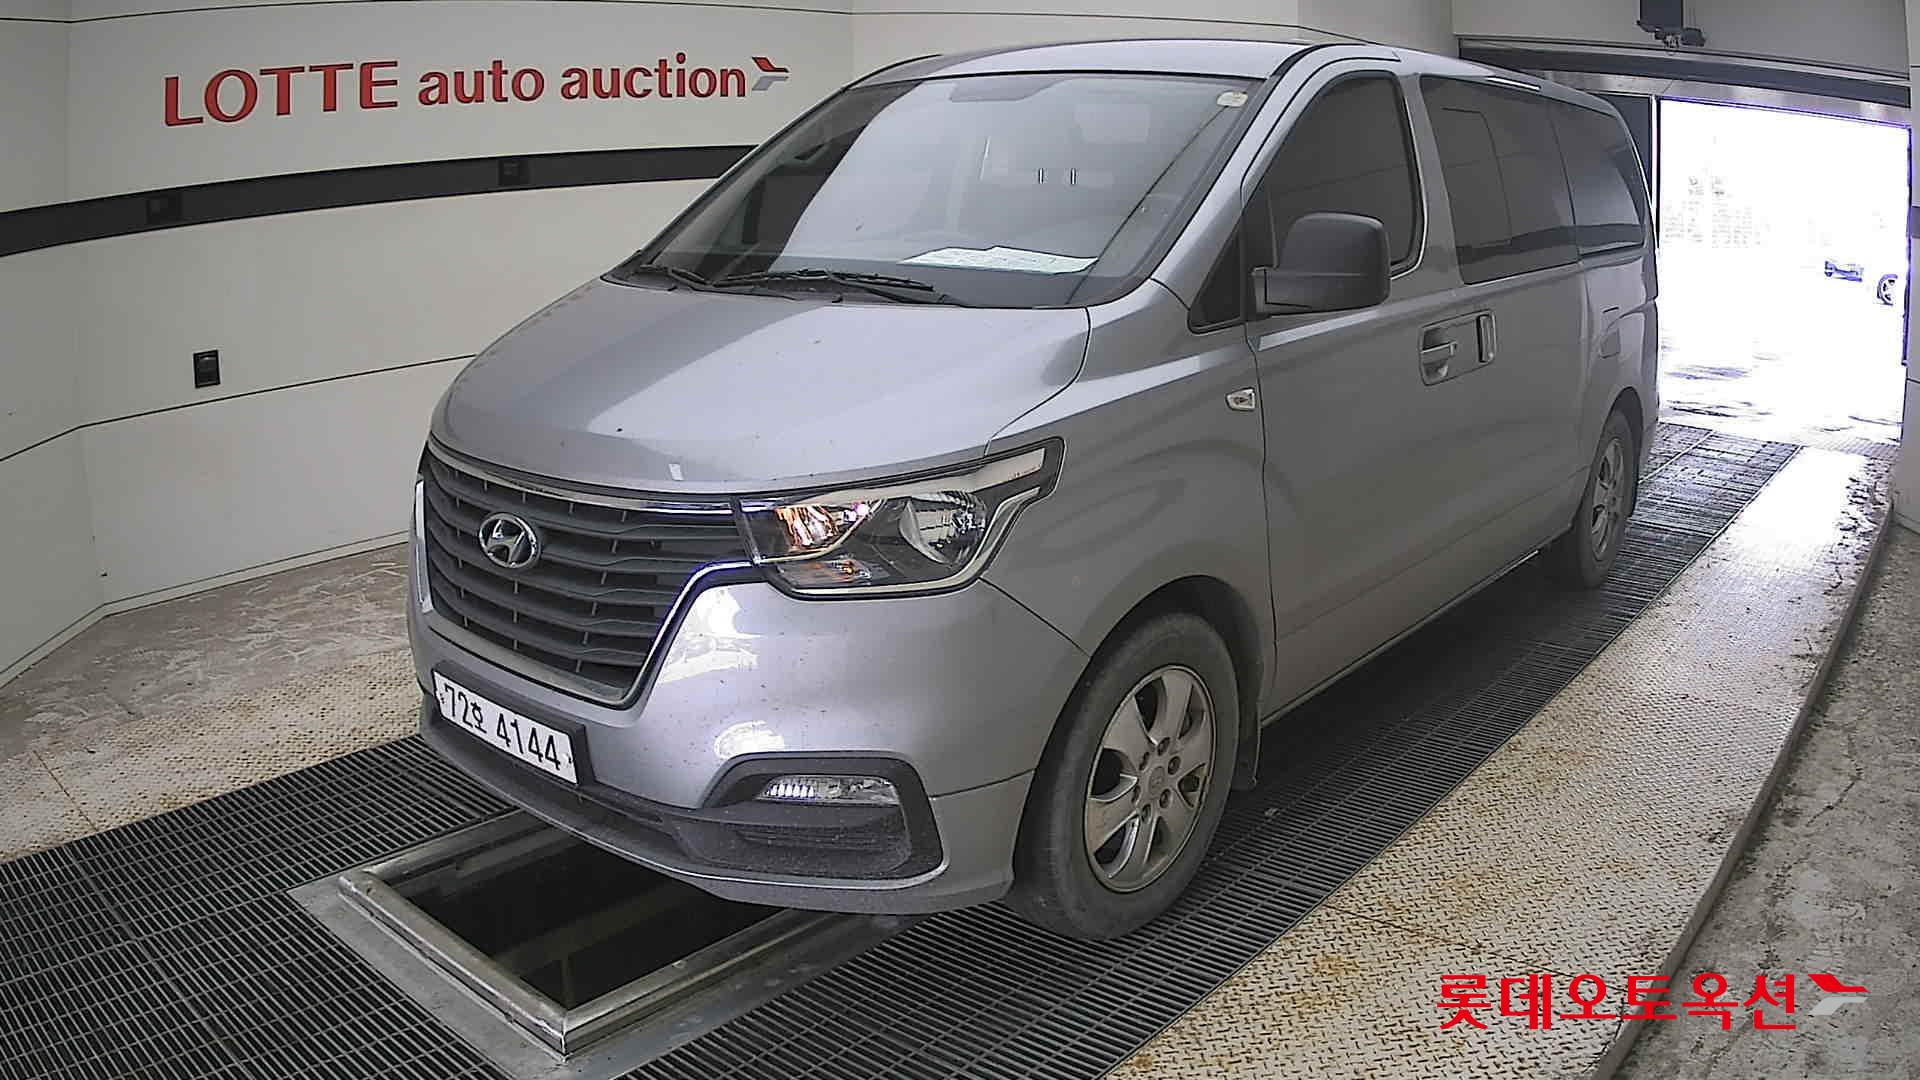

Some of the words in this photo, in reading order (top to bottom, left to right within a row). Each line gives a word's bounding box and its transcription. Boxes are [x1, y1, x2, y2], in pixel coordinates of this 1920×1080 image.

[164, 60, 399, 127] LOTTE
[417, 58, 545, 106] auto
[560, 53, 747, 100] auction
[444, 682, 487, 734] 72호
[496, 712, 561, 771] 4144
